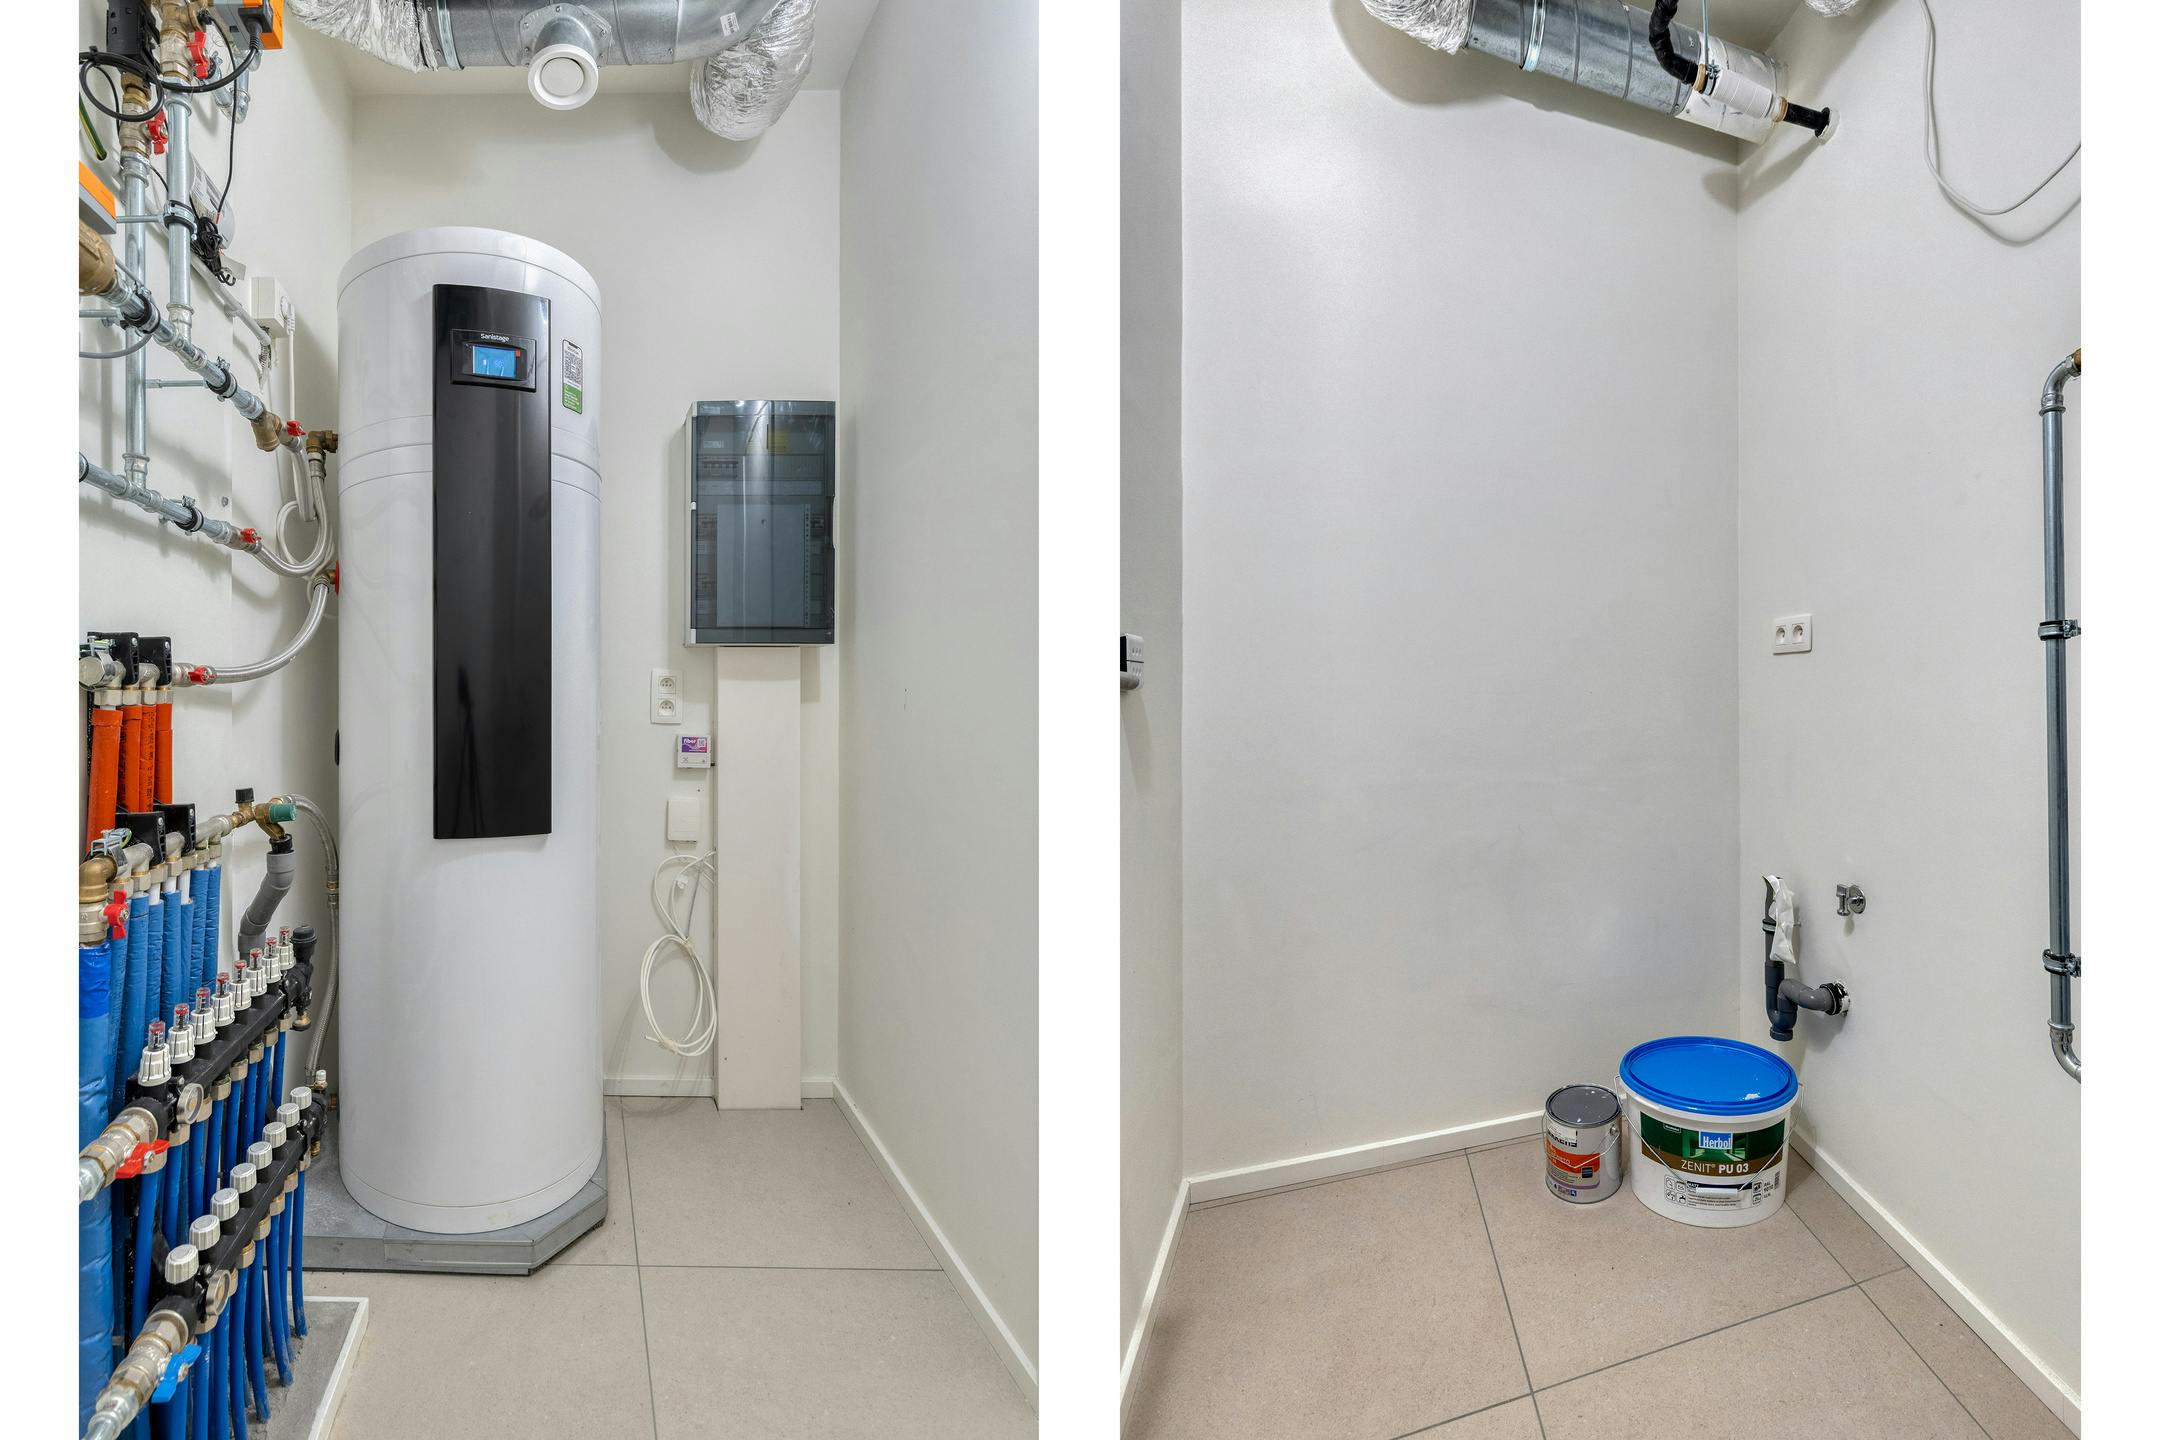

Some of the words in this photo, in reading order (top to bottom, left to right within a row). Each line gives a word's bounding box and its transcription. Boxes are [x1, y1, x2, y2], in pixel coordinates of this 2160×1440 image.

[480, 333, 510, 342] Sanistage
[1702, 1135, 1732, 1149] Herbol
[1718, 1164, 1734, 1174] PU
[1736, 1163, 1749, 1173] 03
